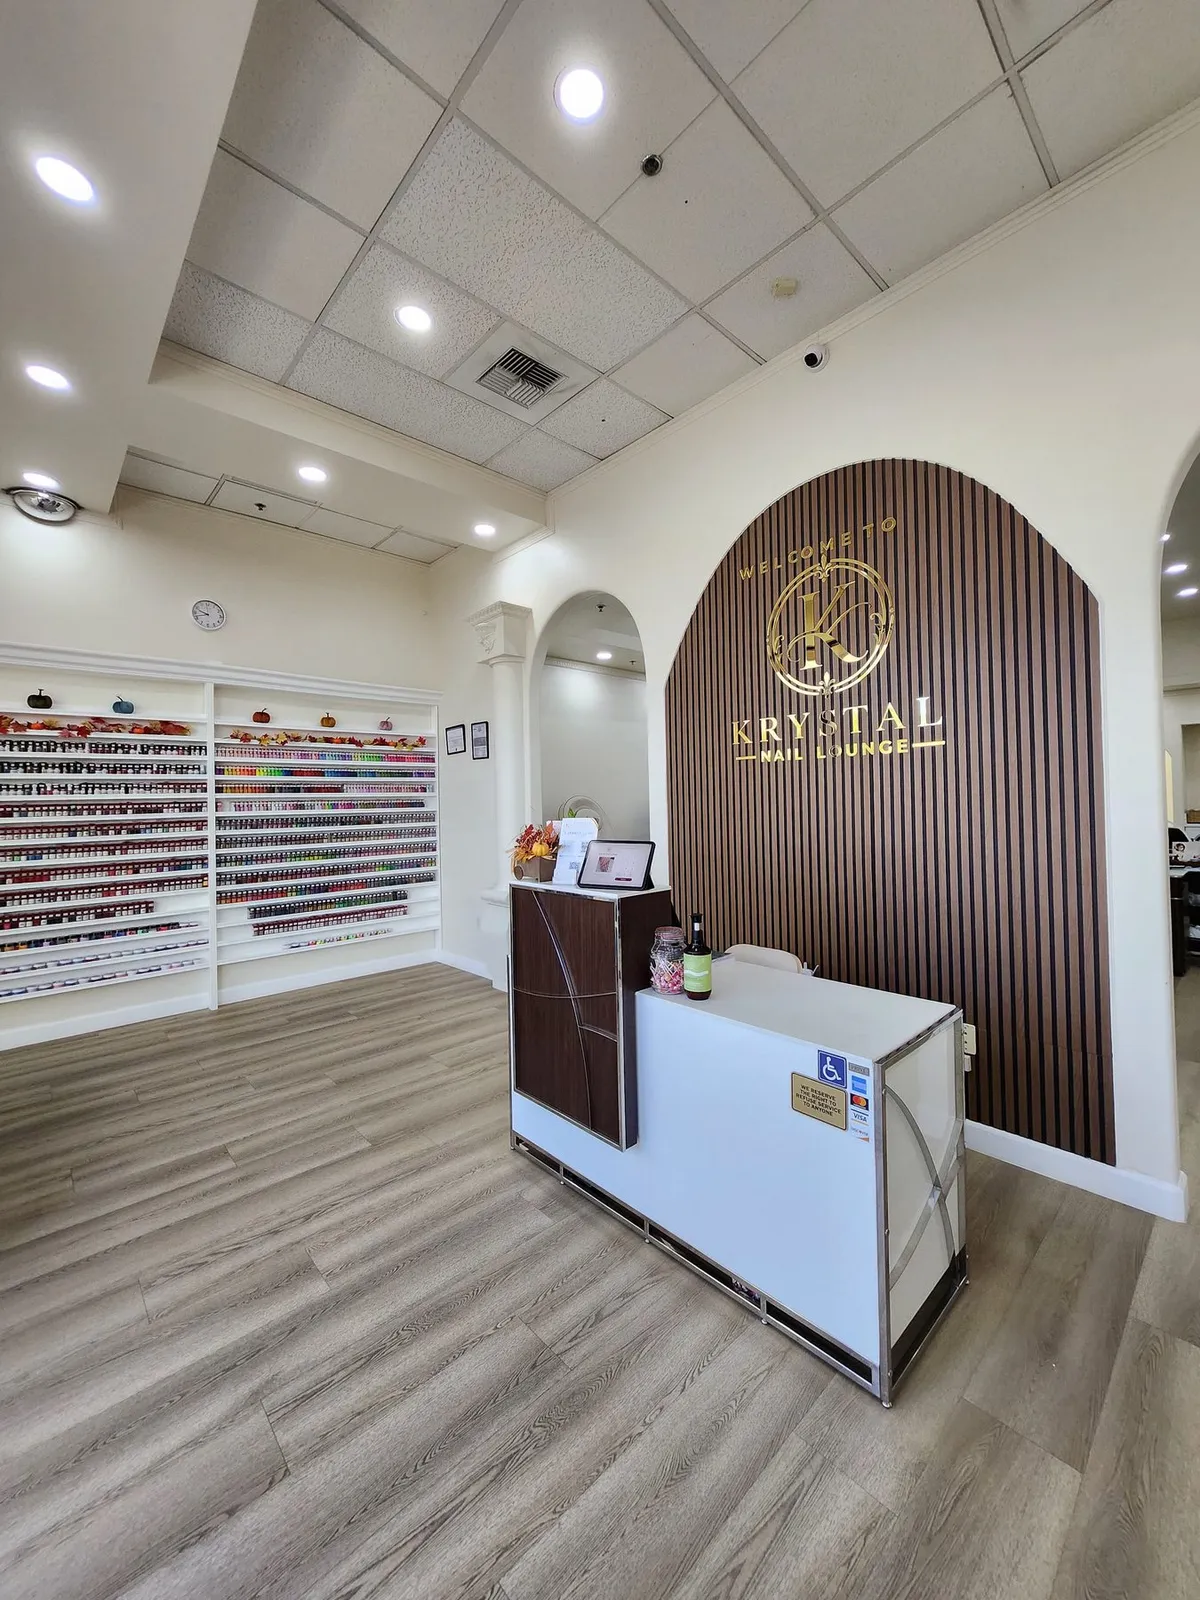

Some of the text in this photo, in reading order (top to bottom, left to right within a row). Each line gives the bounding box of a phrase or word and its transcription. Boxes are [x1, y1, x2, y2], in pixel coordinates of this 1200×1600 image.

[740, 516, 897, 580] WELCOME TO
[787, 581, 872, 671] K
[732, 696, 943, 745] KRYSTAL
[761, 739, 909, 763] NAIL LOUNGE
[795, 1092, 841, 1114] REFUSE SERVICE
[800, 1089, 810, 1097] THE
[811, 1093, 828, 1104] RIGHT
[810, 1088, 836, 1100] RESERVE
[811, 1104, 833, 1116] ANYONE
[853, 1112, 867, 1122] VISA
